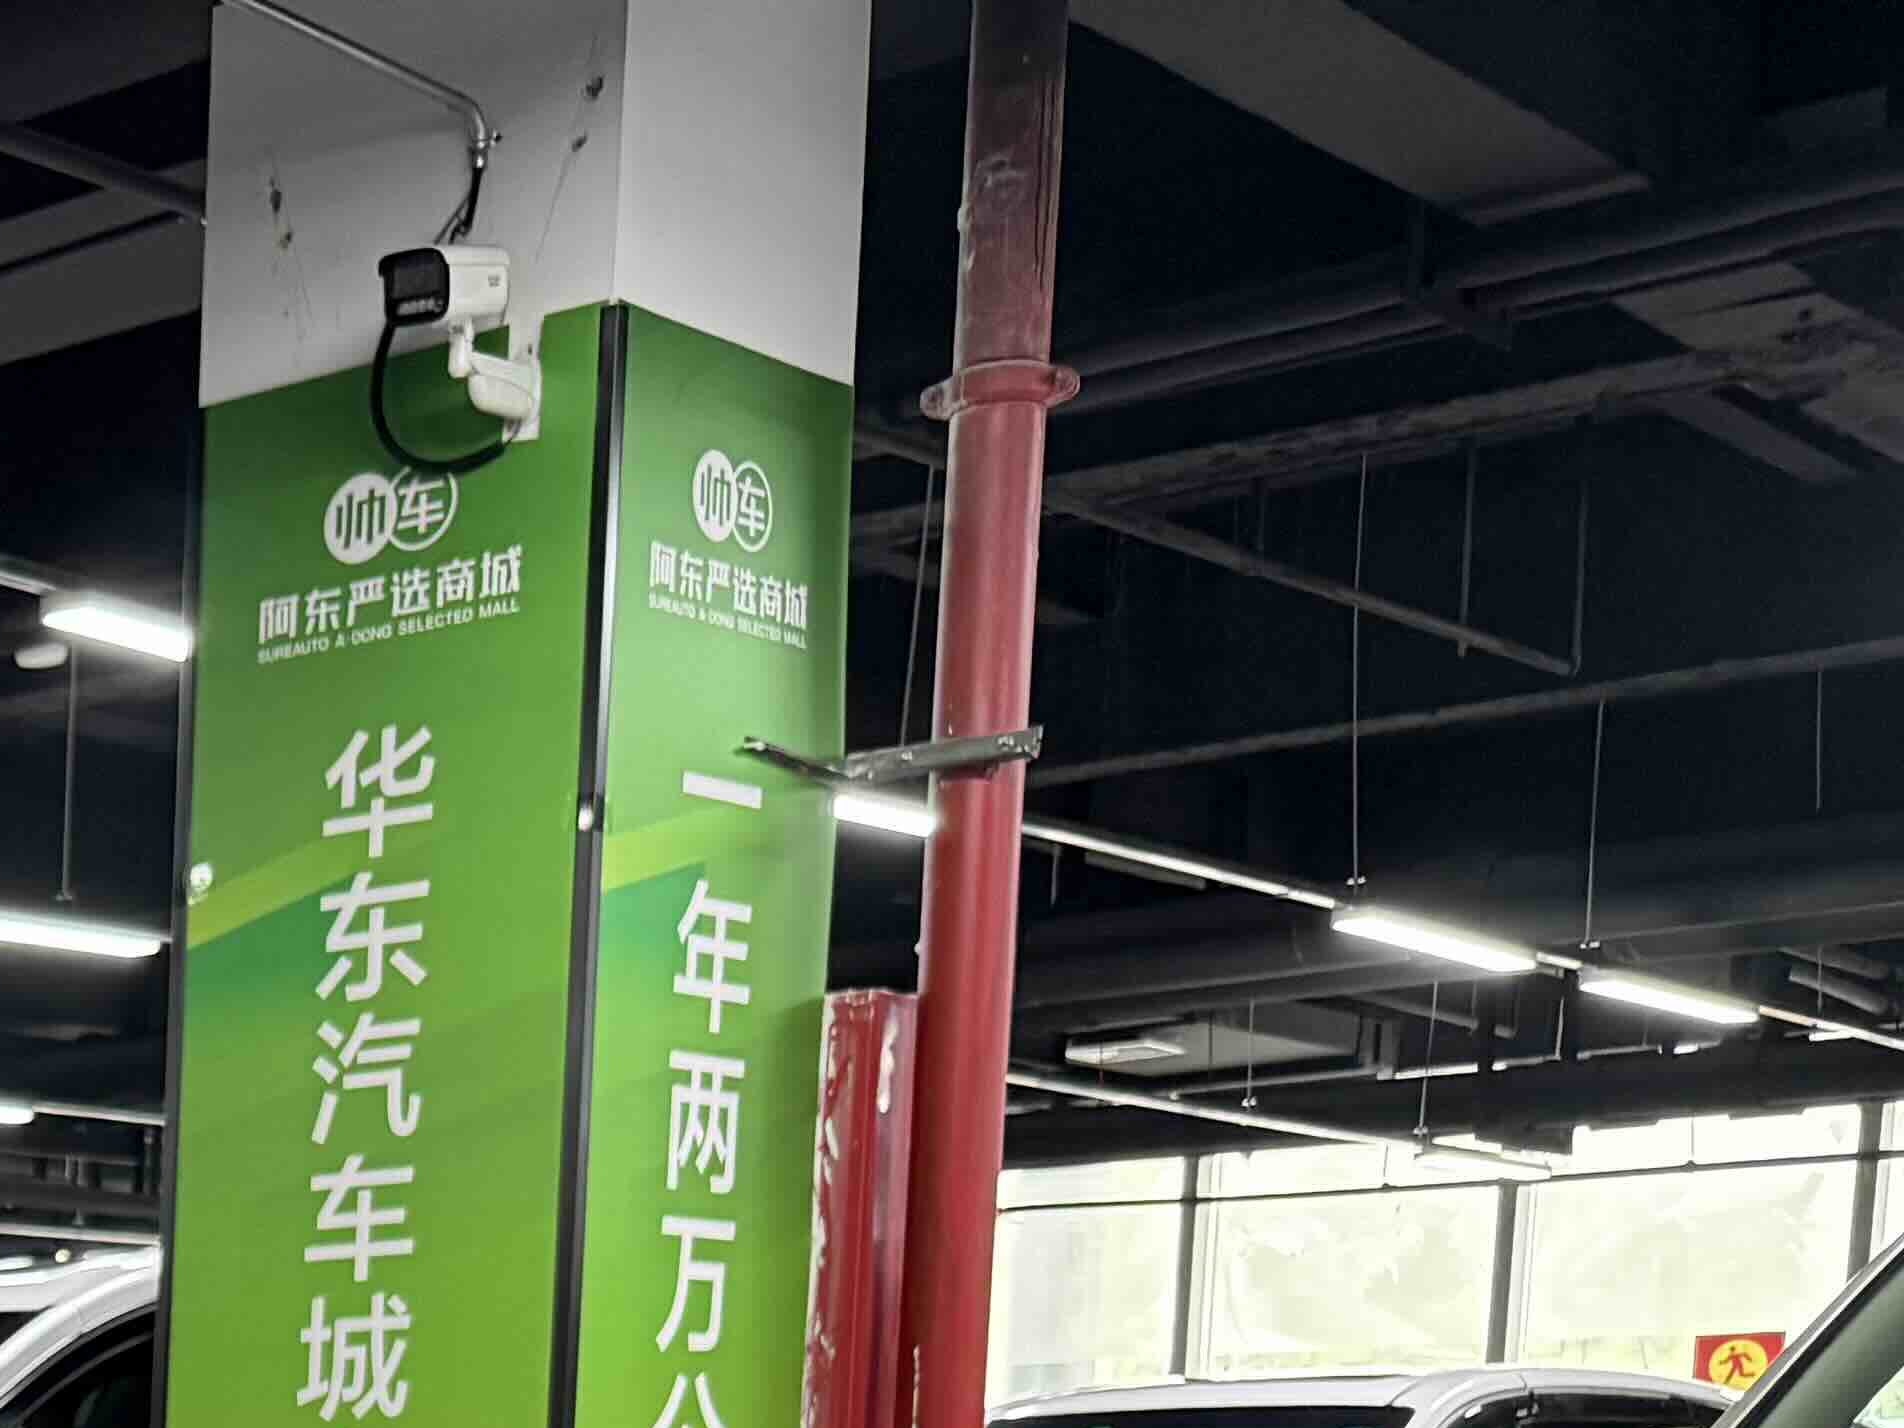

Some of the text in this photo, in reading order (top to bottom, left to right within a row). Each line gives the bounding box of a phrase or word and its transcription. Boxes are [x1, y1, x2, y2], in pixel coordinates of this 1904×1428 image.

[258, 544, 523, 645] 阿东严选商城
[397, 610, 473, 637] SELECTED
[479, 598, 521, 620] MALL
[649, 540, 809, 631] 阿东严选商城
